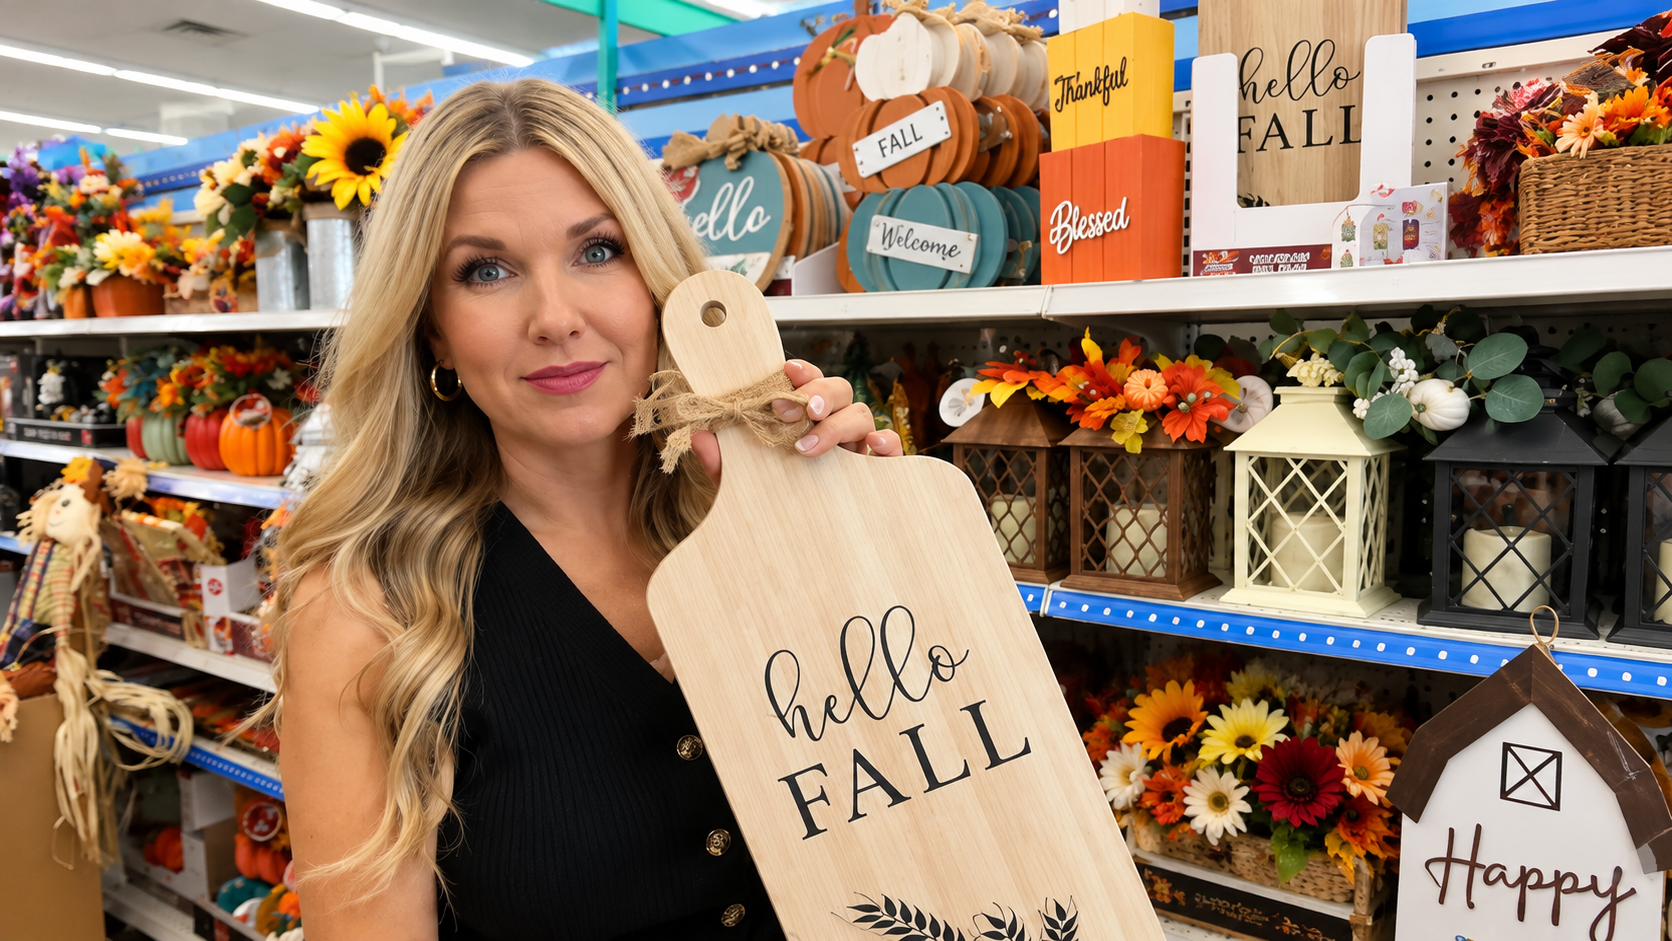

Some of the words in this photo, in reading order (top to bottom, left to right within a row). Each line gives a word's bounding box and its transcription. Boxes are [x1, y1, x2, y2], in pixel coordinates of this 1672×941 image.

[1054, 56, 1129, 112] Thankful
[1239, 38, 1361, 105] hello
[877, 123, 923, 158] FALL
[1237, 104, 1362, 154] FALL
[688, 175, 772, 242] ello
[1049, 196, 1130, 255] Blessed
[881, 222, 961, 260] Welcome
[764, 604, 970, 742] hello
[777, 698, 1032, 841] FALL
[1424, 822, 1637, 941] Happy
